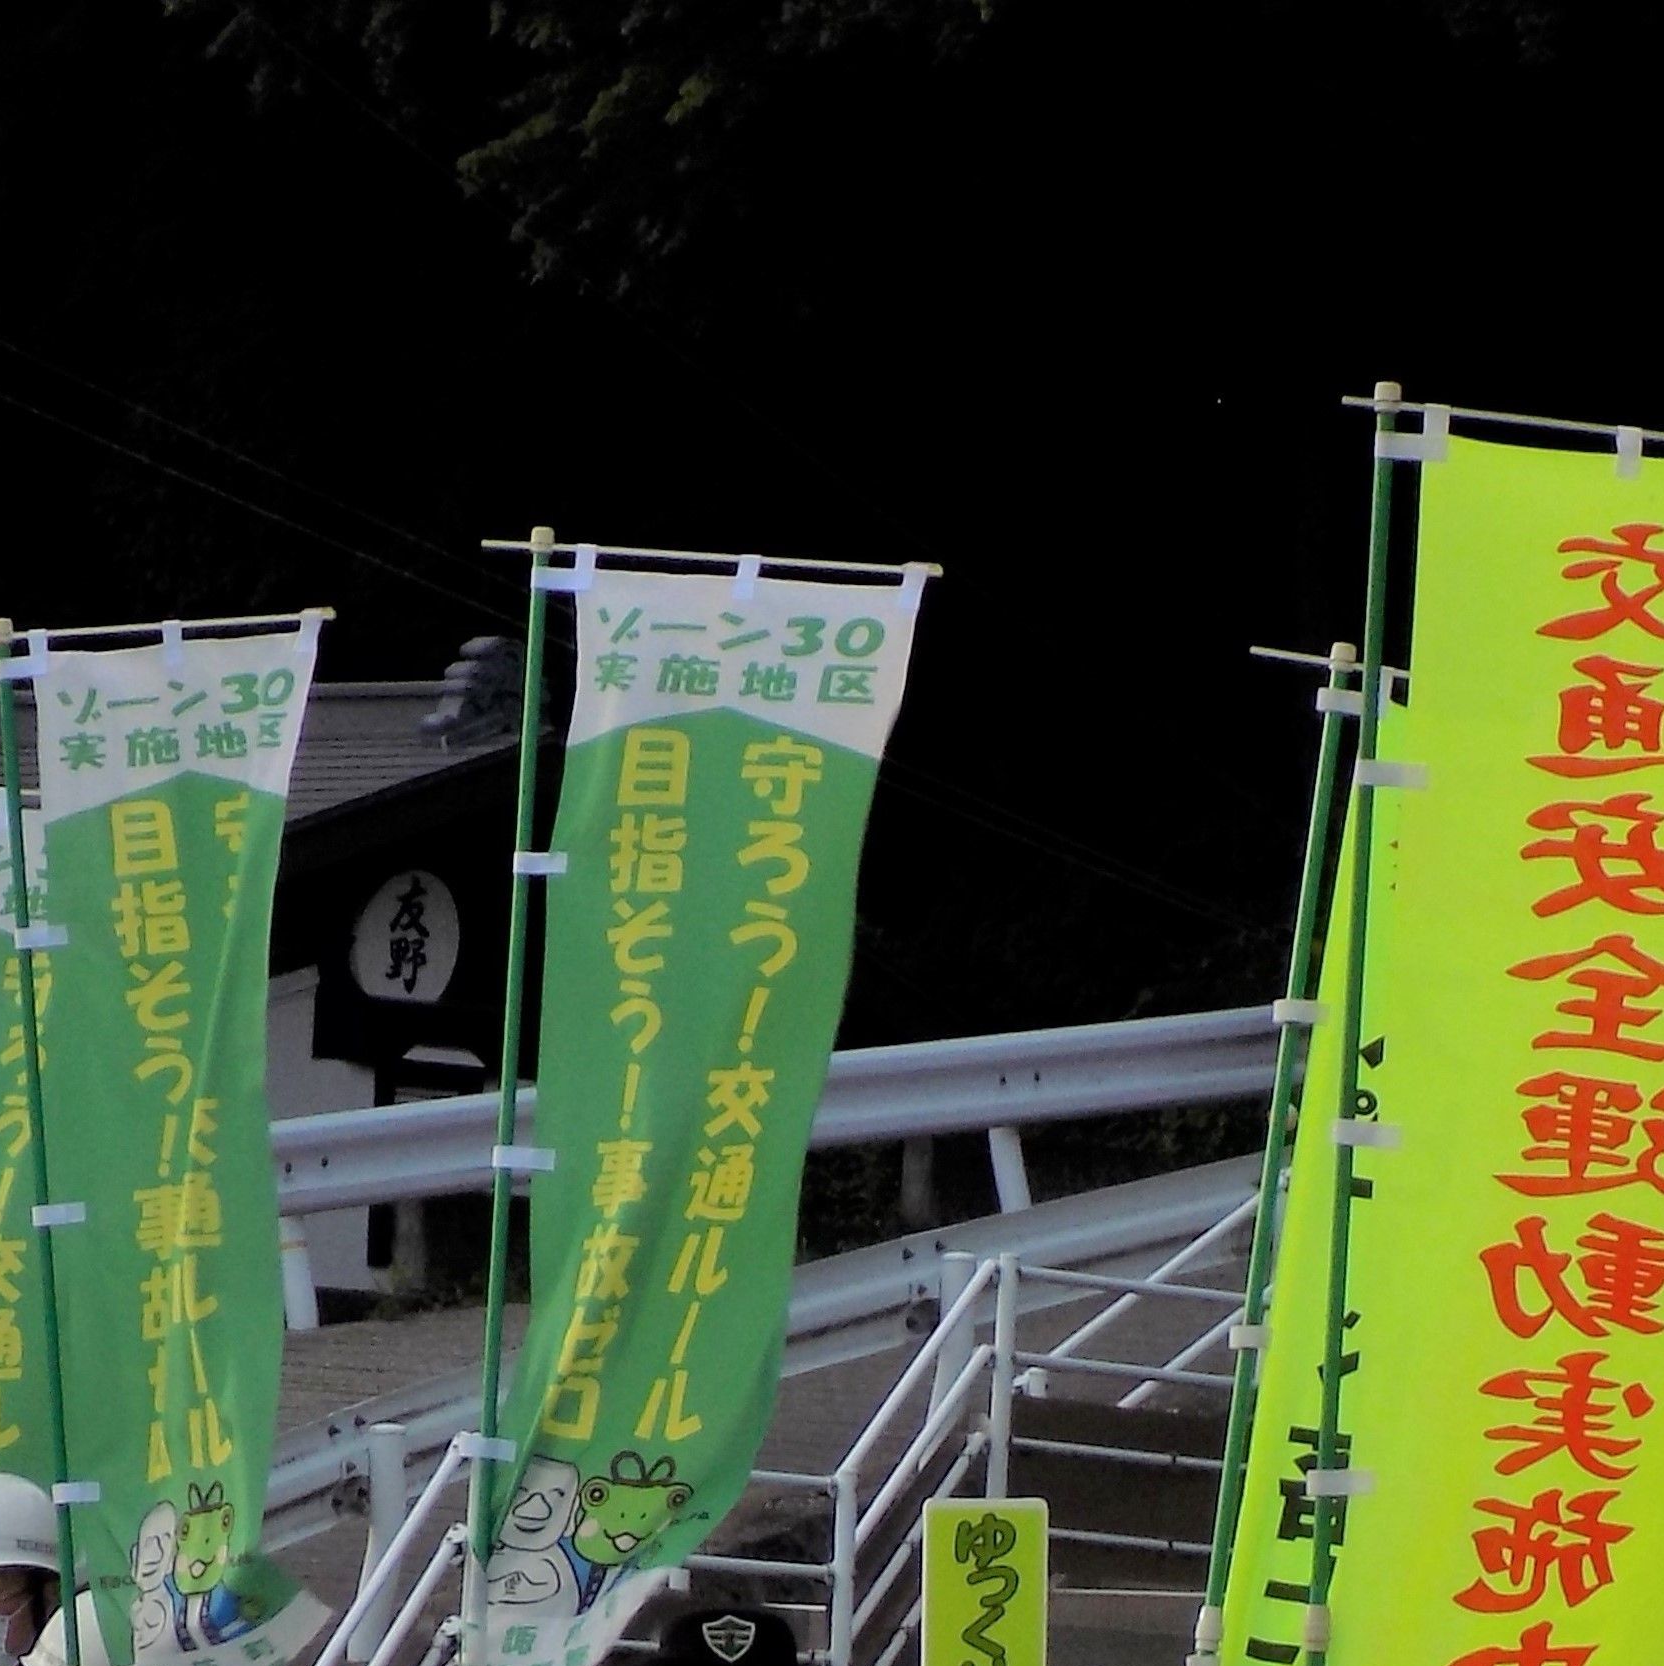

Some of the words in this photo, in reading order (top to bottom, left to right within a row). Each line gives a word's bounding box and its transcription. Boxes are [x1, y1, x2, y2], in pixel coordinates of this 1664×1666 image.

[596, 605, 886, 657] ゾーン30
[56, 667, 296, 725] ゾーン30
[593, 651, 879, 704] 実施地区
[386, 873, 430, 994] 友野
[541, 726, 690, 1441] 目指そう！事故ゼロ
[634, 734, 824, 1443] 守ろう！交通ルール
